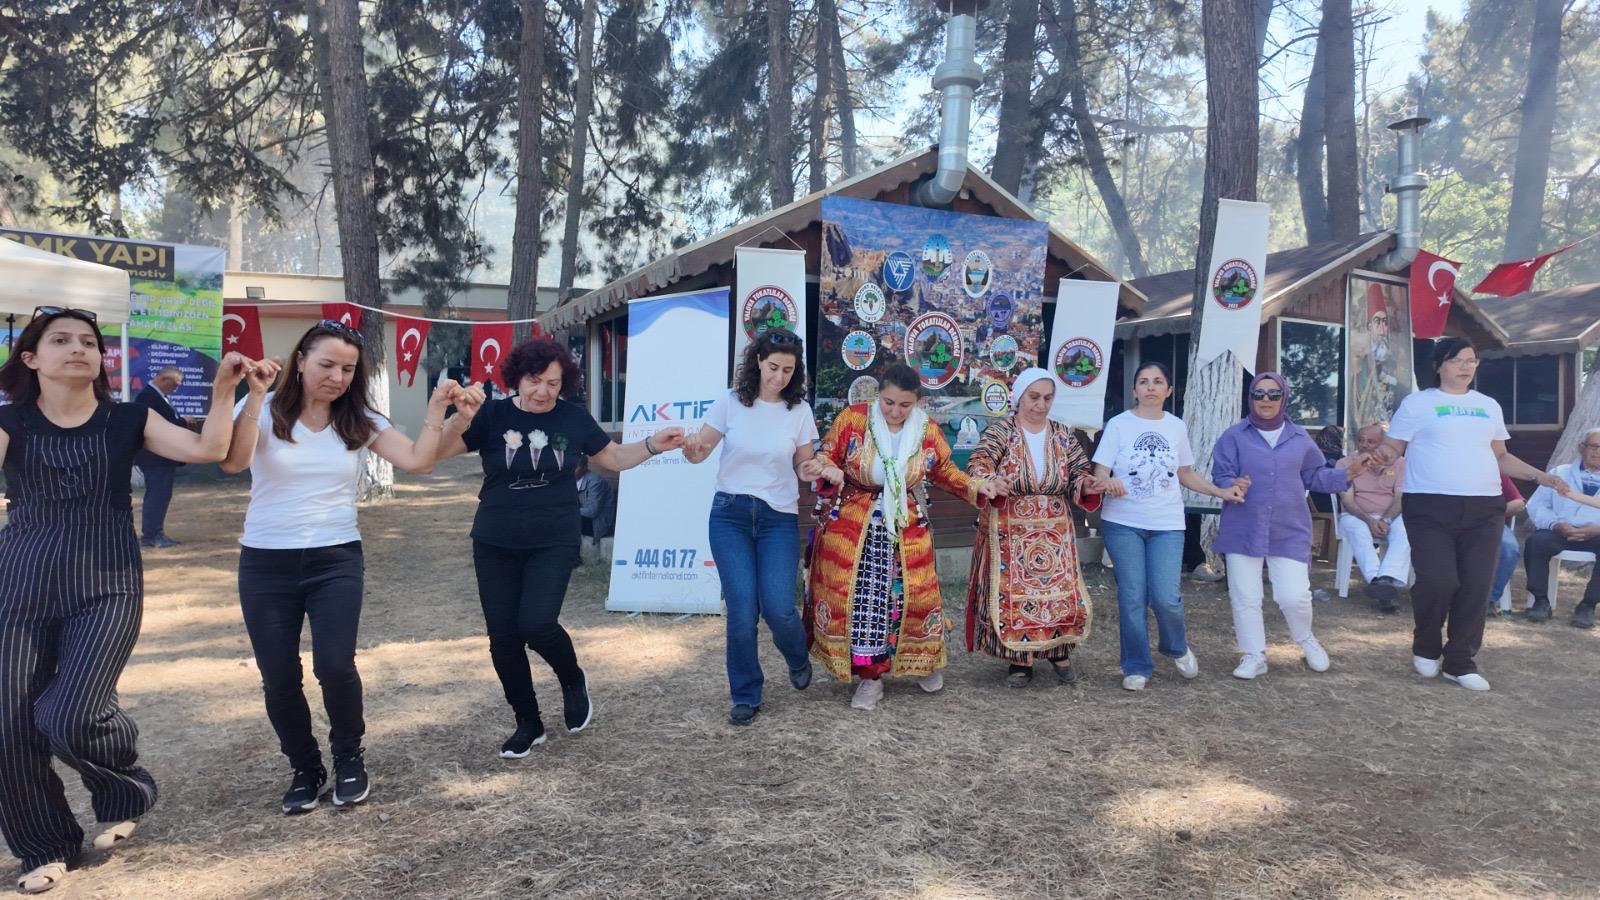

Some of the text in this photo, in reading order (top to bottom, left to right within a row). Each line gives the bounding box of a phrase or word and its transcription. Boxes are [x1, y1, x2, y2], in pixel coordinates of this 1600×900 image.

[1, 233, 166, 267] MK YAPI
[127, 269, 167, 279] motiv
[744, 299, 755, 321] YALOVA
[908, 328, 919, 355] YALOVA
[917, 317, 951, 331] TOKATLILAR
[949, 327, 961, 357] DERNEĞİ
[634, 549, 697, 568] 444 61 77
